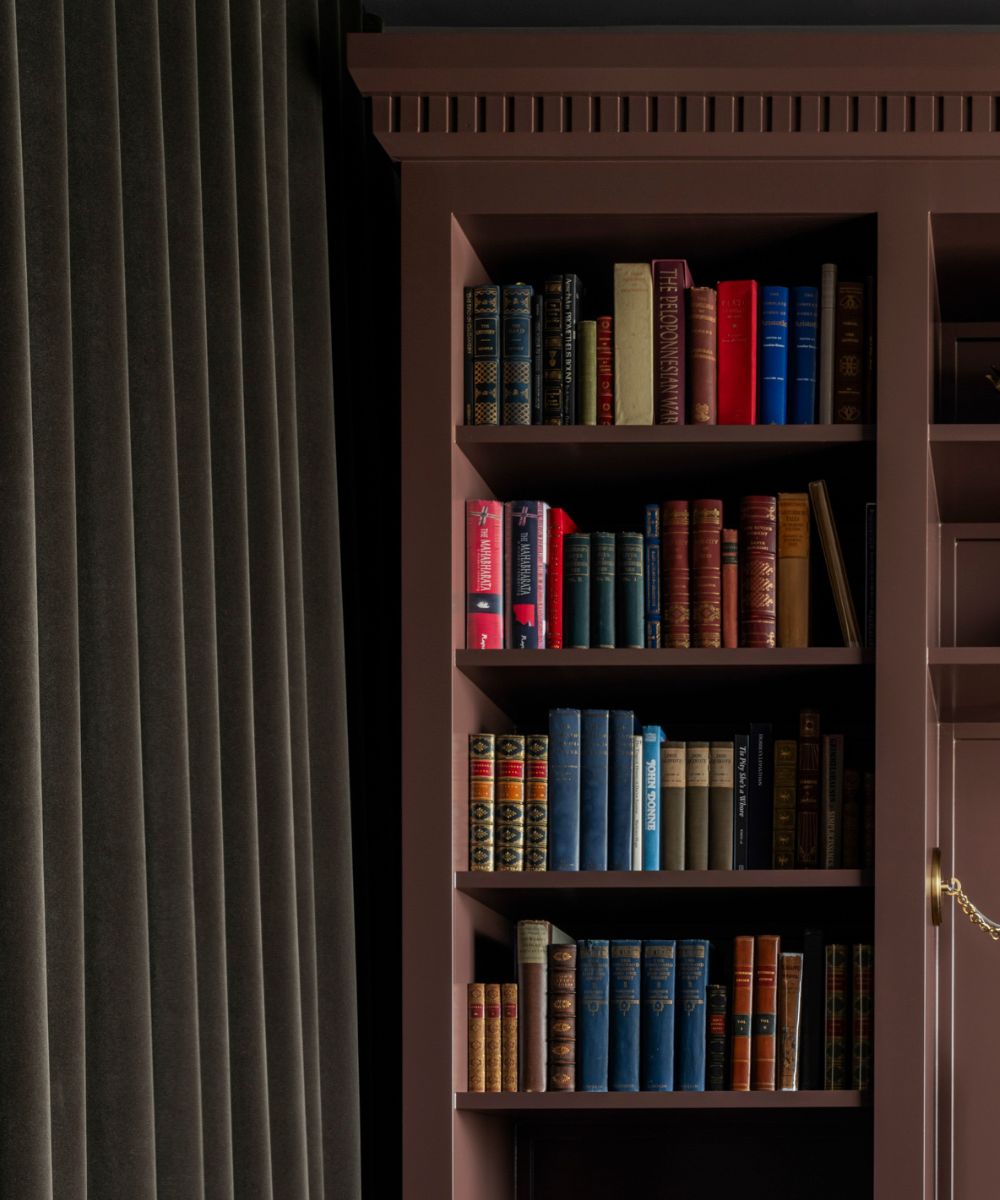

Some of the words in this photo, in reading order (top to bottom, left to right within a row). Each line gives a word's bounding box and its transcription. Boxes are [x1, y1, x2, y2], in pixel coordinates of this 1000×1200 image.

[659, 268, 678, 292] THE
[659, 295, 678, 393] PELOPONNESIAN
[659, 396, 678, 424] WAR
[480, 528, 489, 538] THE
[520, 532, 529, 542] THE
[480, 539, 492, 591] MAHABHARATA
[520, 543, 532, 596] MAHABHARATA
[646, 759, 657, 789] JOHN
[737, 757, 747, 771] Pity
[739, 772, 747, 789] She's
[646, 791, 657, 831] DONNE
[739, 795, 747, 818] Whore
